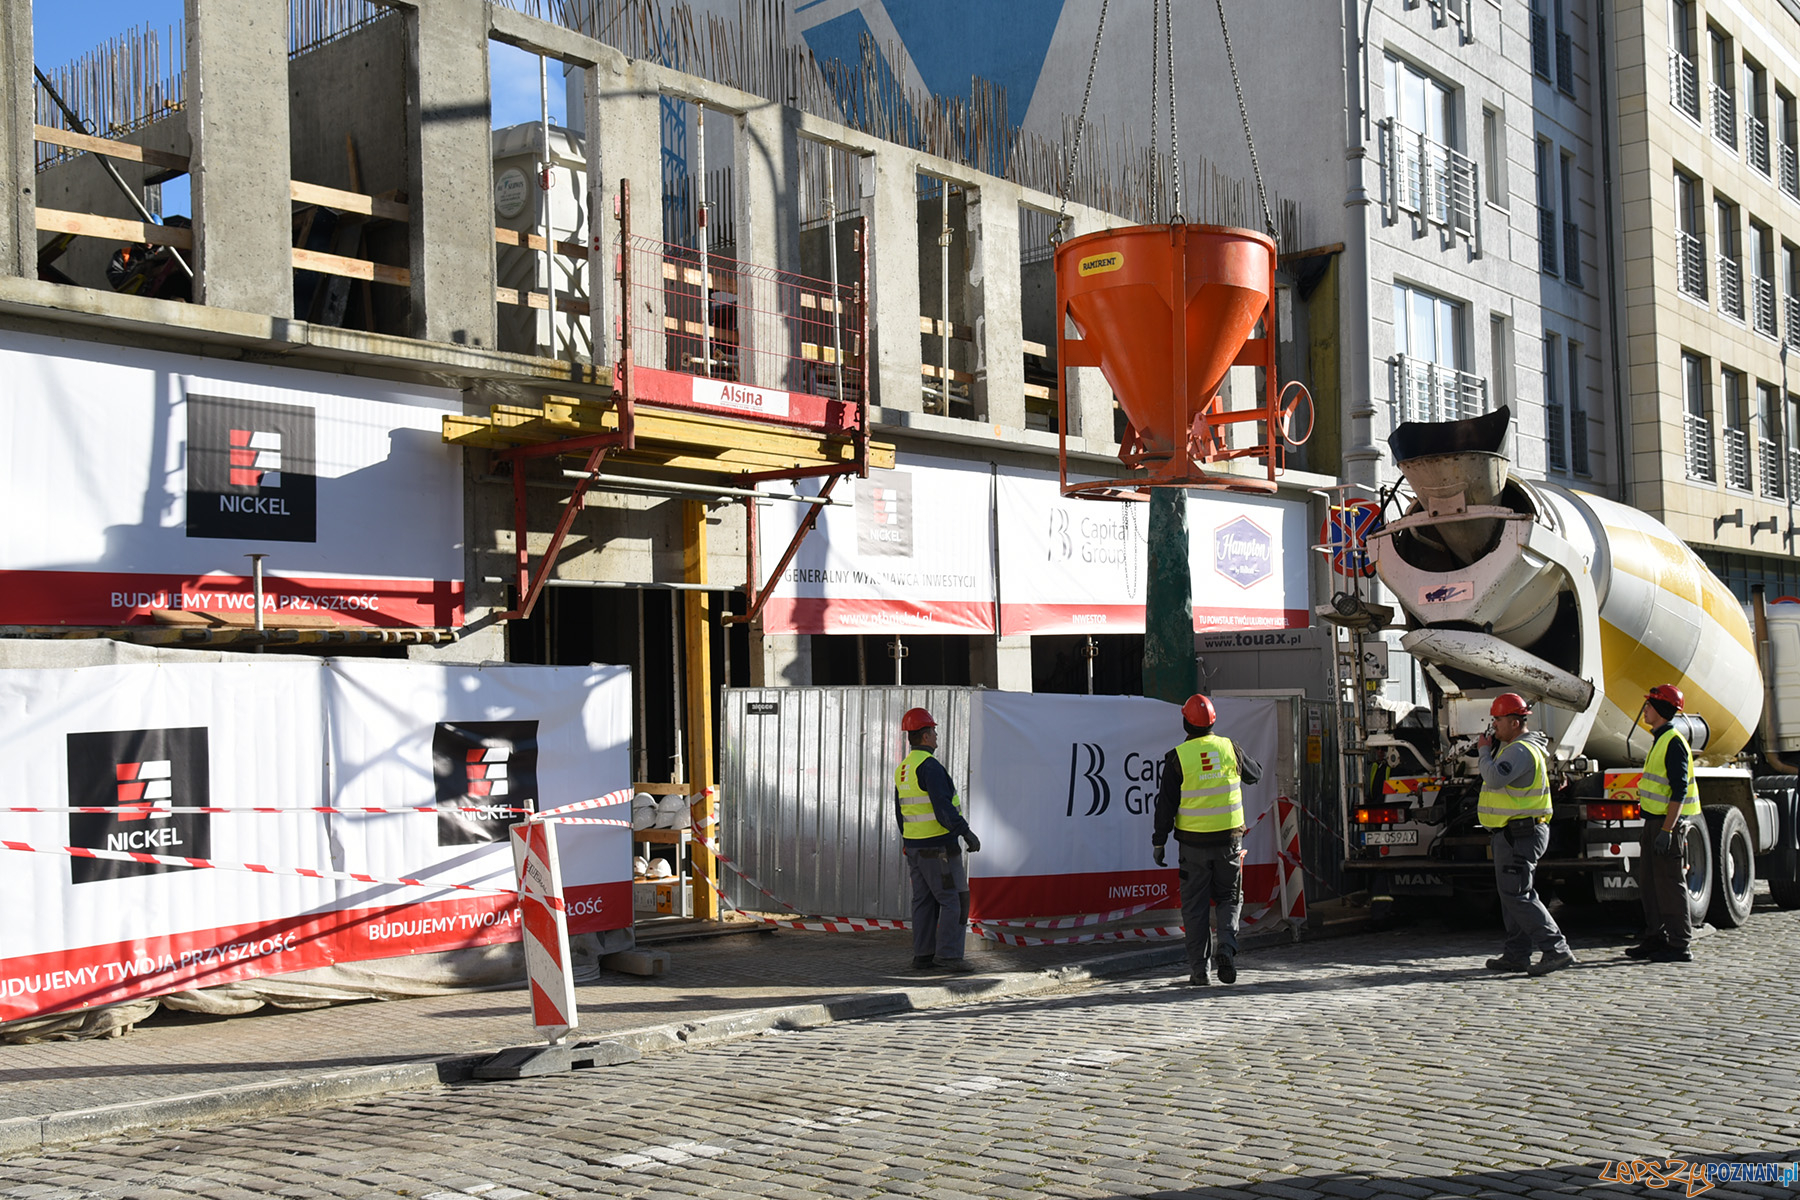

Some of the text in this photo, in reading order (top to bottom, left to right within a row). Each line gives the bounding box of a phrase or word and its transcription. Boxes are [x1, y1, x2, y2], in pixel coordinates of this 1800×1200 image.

[1082, 257, 1117, 271] RAMIRENT
[720, 385, 763, 406] Alsina
[219, 494, 291, 516] NICKEL
[869, 529, 902, 542] NICKEL
[1080, 517, 1130, 545] Capital
[1081, 541, 1126, 570] Group
[1216, 533, 1271, 561] Hampton
[784, 569, 850, 584] GENERALNY
[922, 574, 976, 588] INWESTYCJI
[110, 592, 380, 613] BUDUJEMY TWOĄ PRZYSZŁOŚĆ
[1072, 614, 1107, 625] INWESTOR
[1205, 633, 1302, 649] www.touax.pl
[460, 804, 518, 821] NICKEL
[107, 827, 183, 851] NICKEL
[1366, 832, 1416, 844] PZ 059AX
[1394, 874, 1443, 886] MAN
[1603, 876, 1640, 888] MA
[1108, 883, 1168, 899] INWESTOR
[368, 915, 457, 940] BUDUJEMY
[458, 909, 513, 931] TWOJĄ
[0, 931, 297, 998] DUJEMY TWOJĄ PRZYSZŁOŚĆ
